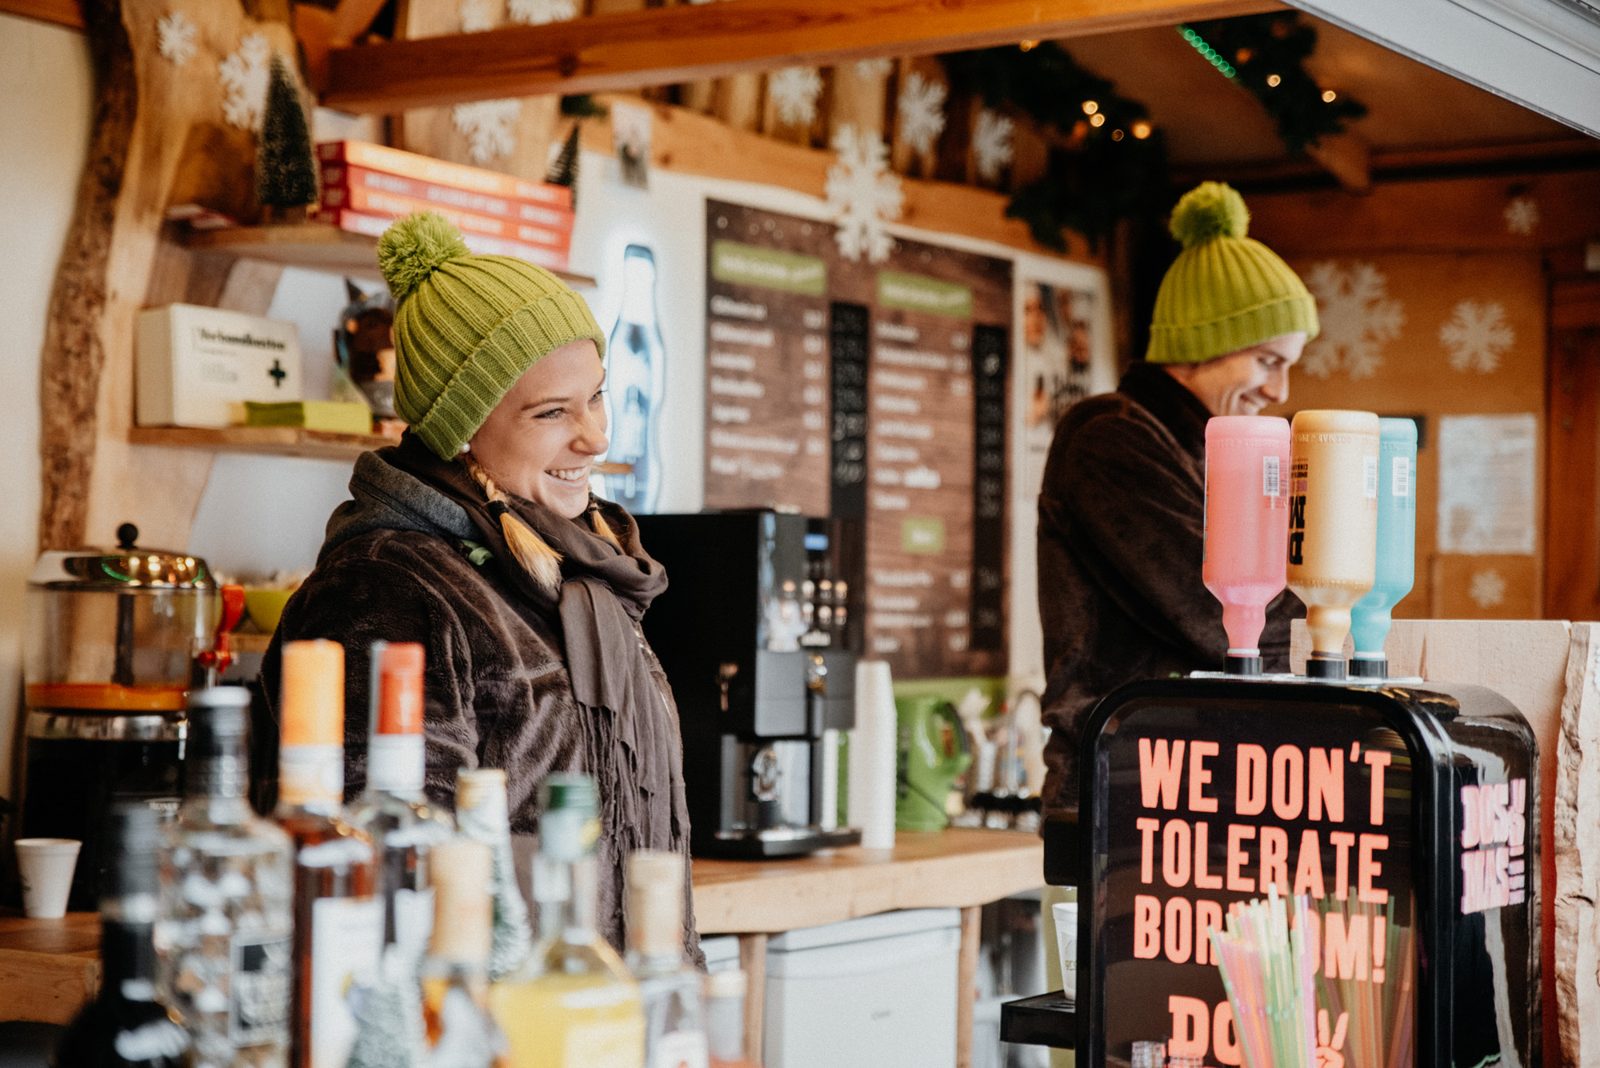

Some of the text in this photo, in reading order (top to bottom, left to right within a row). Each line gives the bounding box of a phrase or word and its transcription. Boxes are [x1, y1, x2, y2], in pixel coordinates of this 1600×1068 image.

[1138, 738, 1392, 825] WE DON'T
[1136, 817, 1389, 904] TOLERATE
